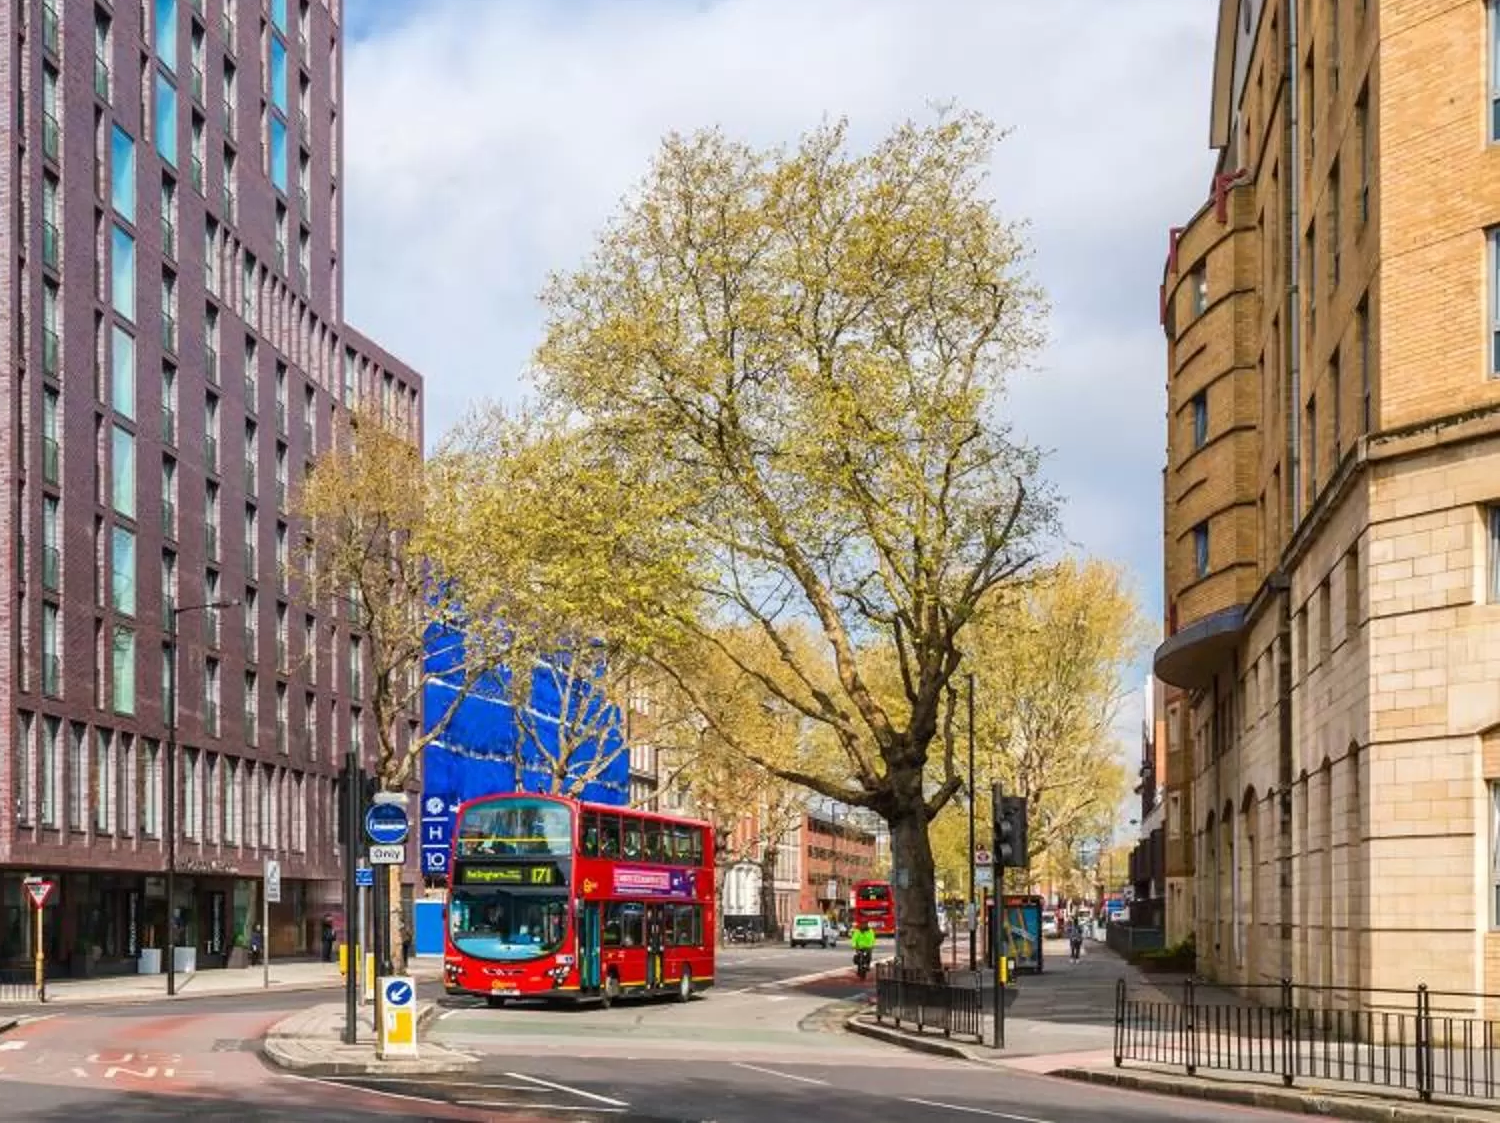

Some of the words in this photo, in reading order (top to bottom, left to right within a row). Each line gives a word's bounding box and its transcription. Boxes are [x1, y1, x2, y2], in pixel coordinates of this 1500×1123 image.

[429, 825, 443, 840] H
[425, 852, 445, 866] 10
[531, 866, 551, 883] 171
